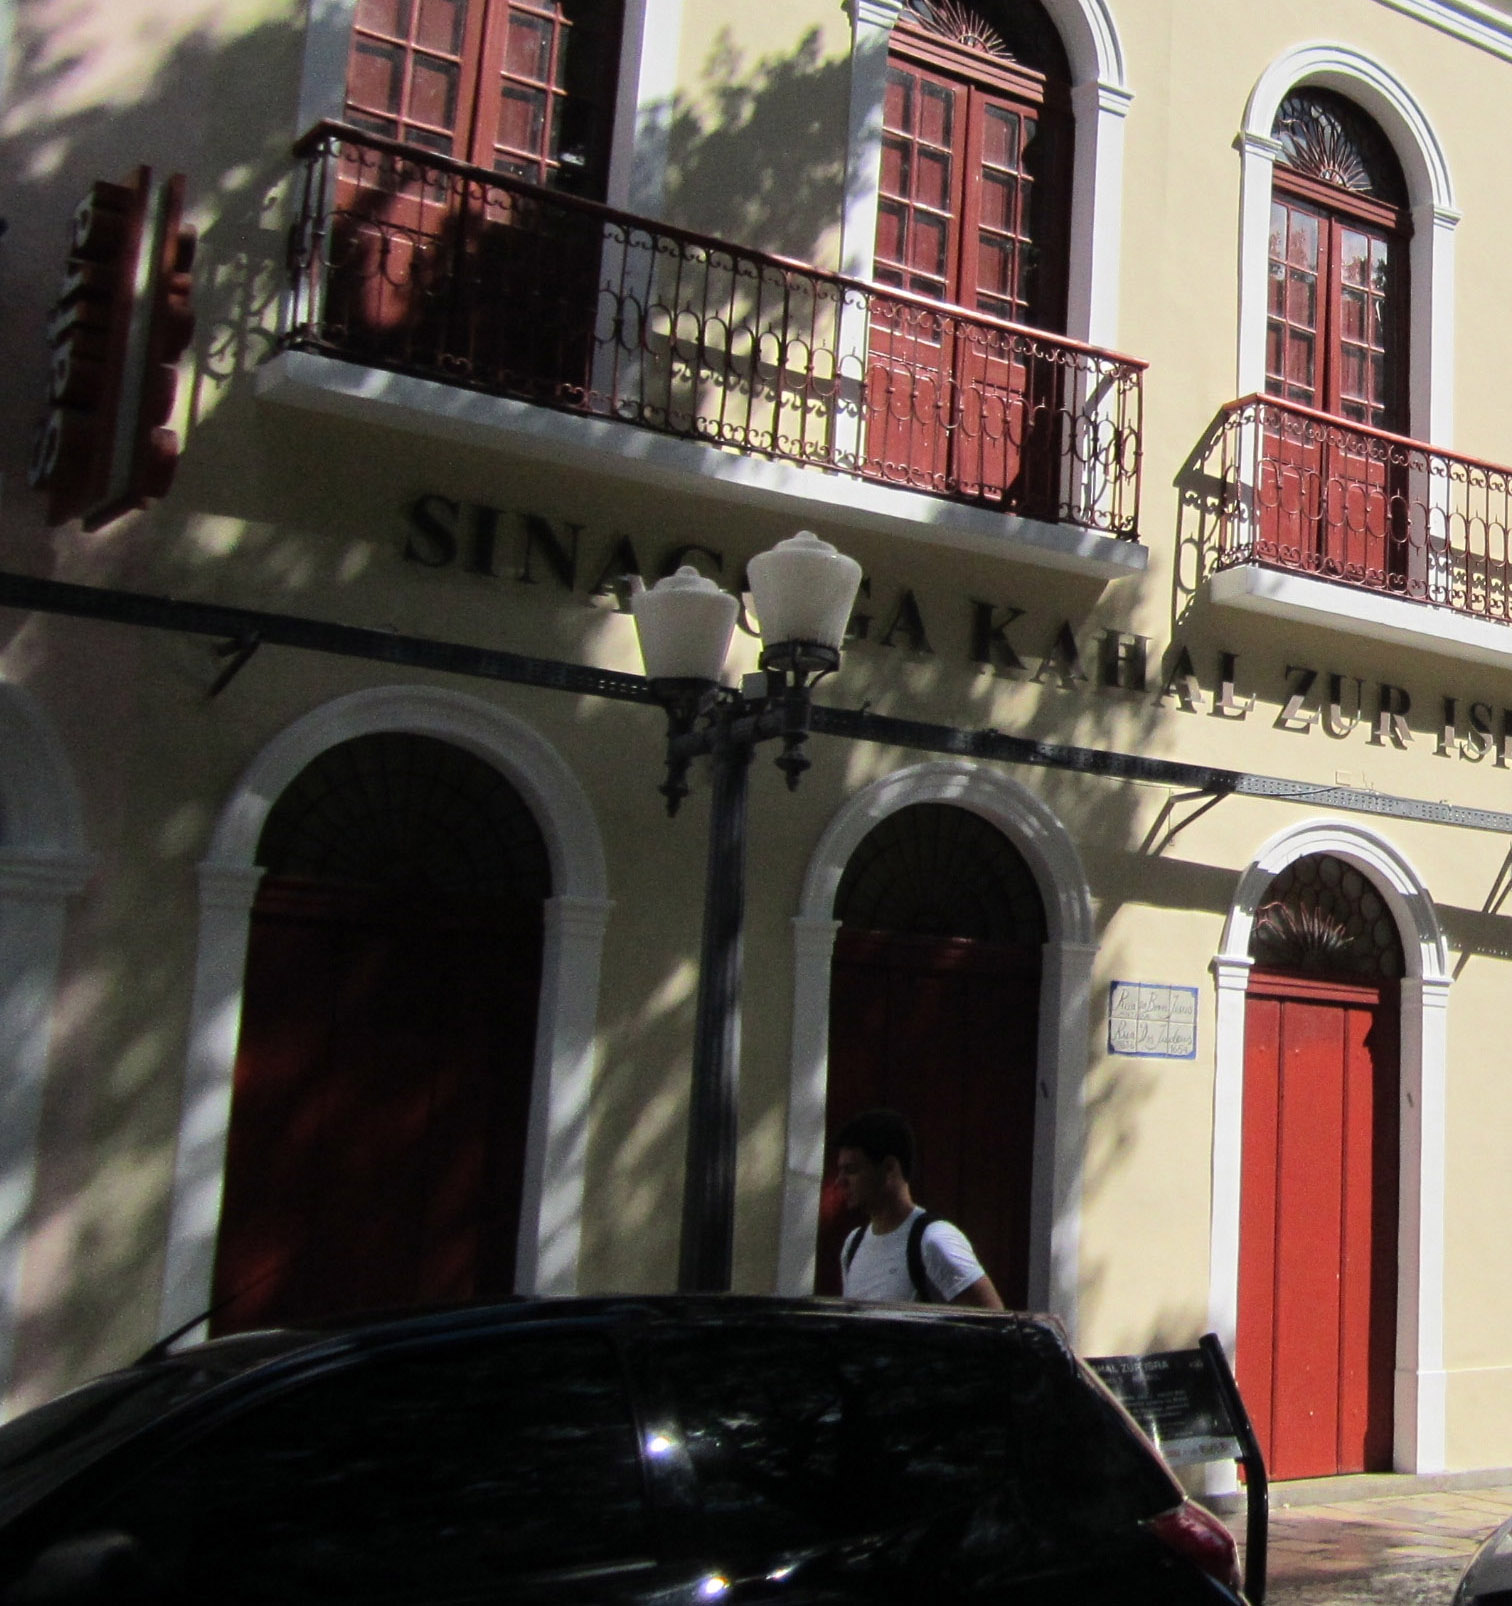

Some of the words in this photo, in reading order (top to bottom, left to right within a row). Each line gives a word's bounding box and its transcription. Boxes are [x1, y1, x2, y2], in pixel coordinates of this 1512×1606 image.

[404, 493, 936, 655] SINAA
[968, 599, 1256, 718] KAHAL
[1275, 665, 1414, 748] ZUR
